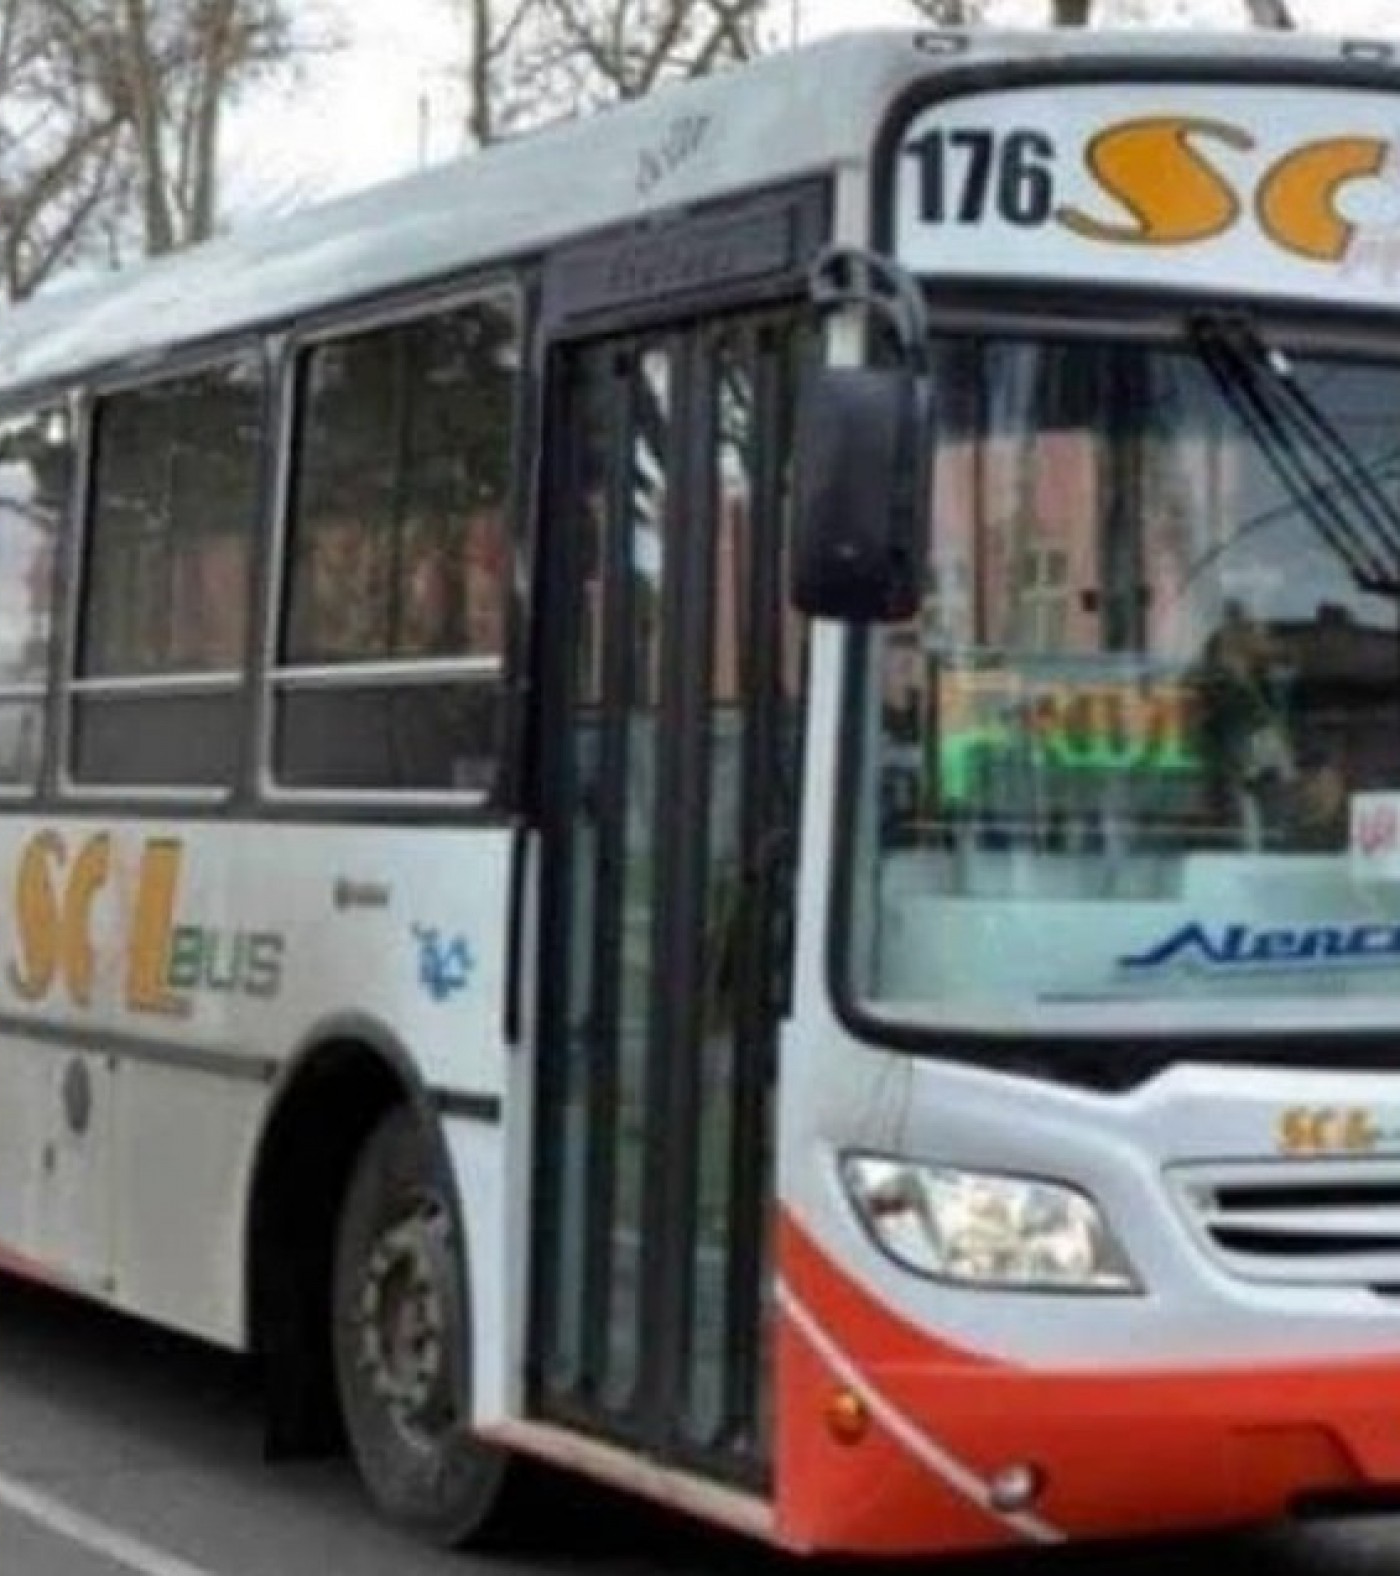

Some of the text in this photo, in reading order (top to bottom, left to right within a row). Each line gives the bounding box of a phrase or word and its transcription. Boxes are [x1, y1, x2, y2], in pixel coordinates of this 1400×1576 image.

[903, 127, 1055, 227] 176
[168, 925, 285, 996] BUS
[1116, 919, 1400, 967] Alenc
